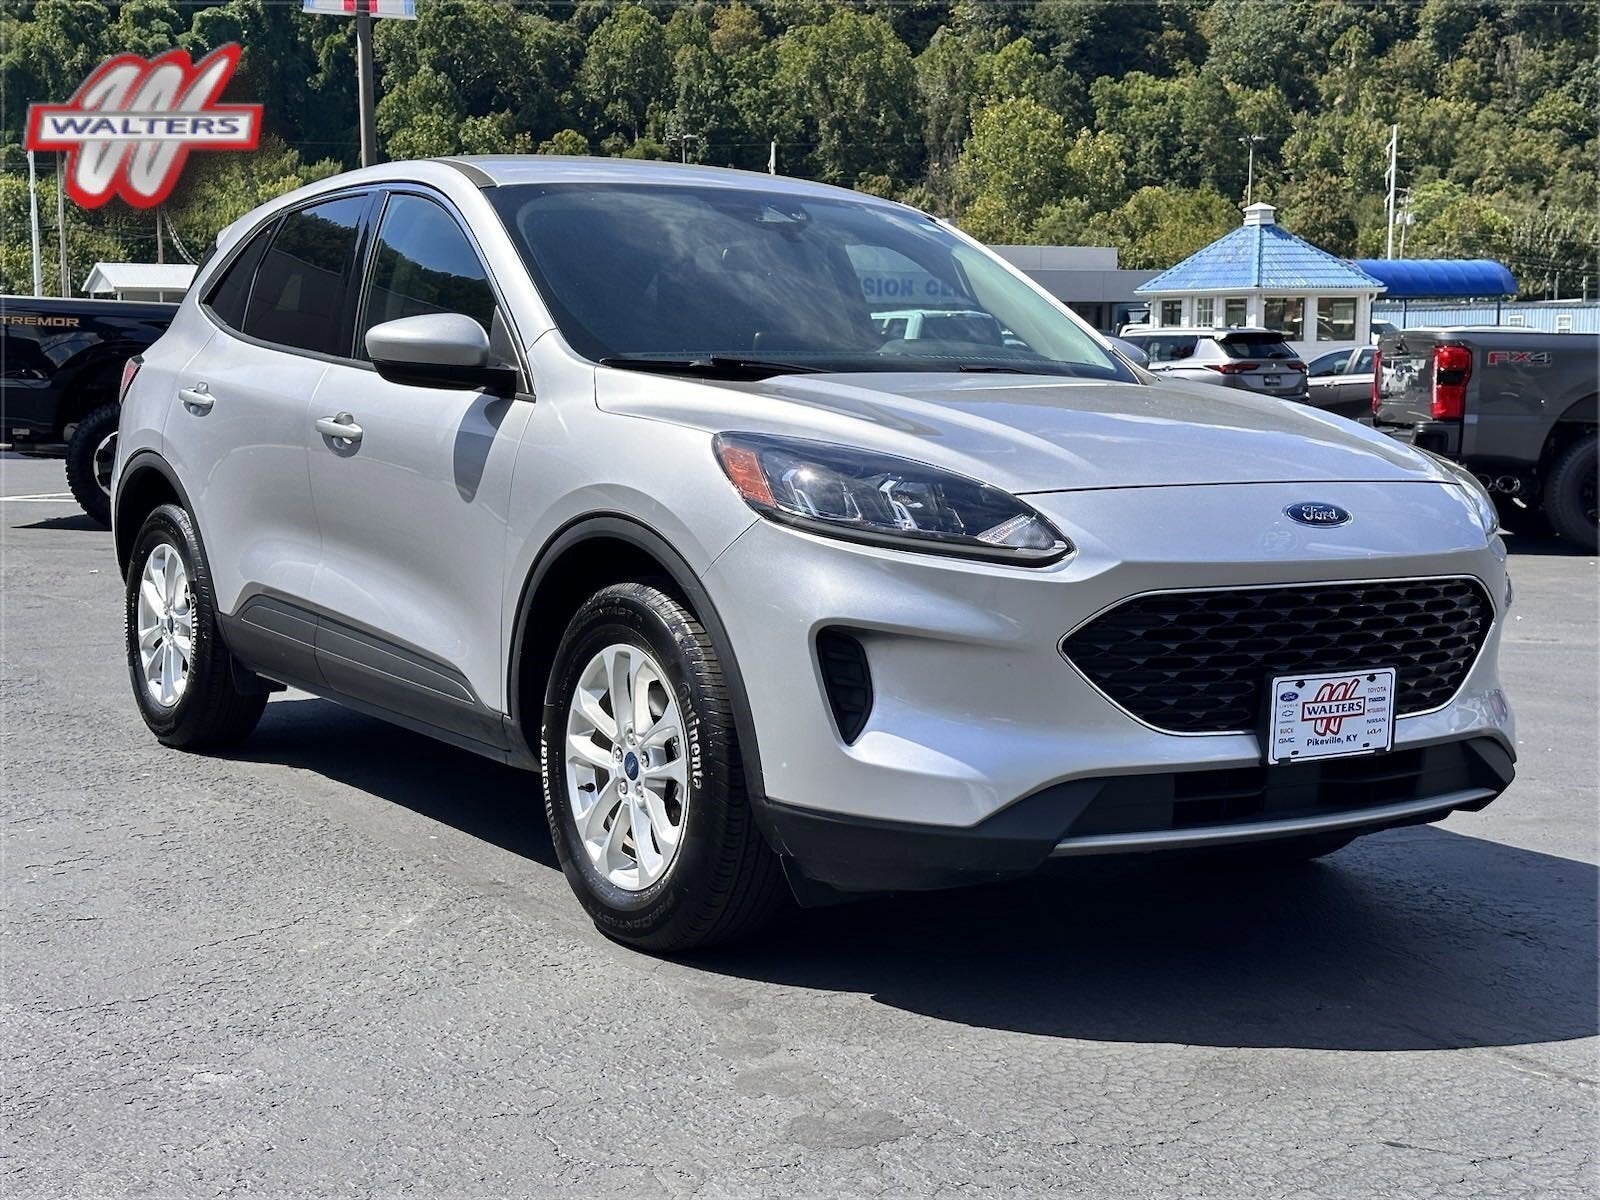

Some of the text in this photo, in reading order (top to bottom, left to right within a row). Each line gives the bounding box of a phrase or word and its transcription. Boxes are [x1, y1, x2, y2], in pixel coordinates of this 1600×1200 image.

[0, 316, 80, 328] TREMOR
[1488, 351, 1552, 367] FX4
[1367, 686, 1387, 694] TOYOTA
[1283, 692, 1296, 701] Ford
[1306, 701, 1362, 716] WALTERS
[1366, 717, 1386, 725] NISSAN
[1280, 727, 1295, 735] BUICK
[1346, 733, 1358, 743] KY
